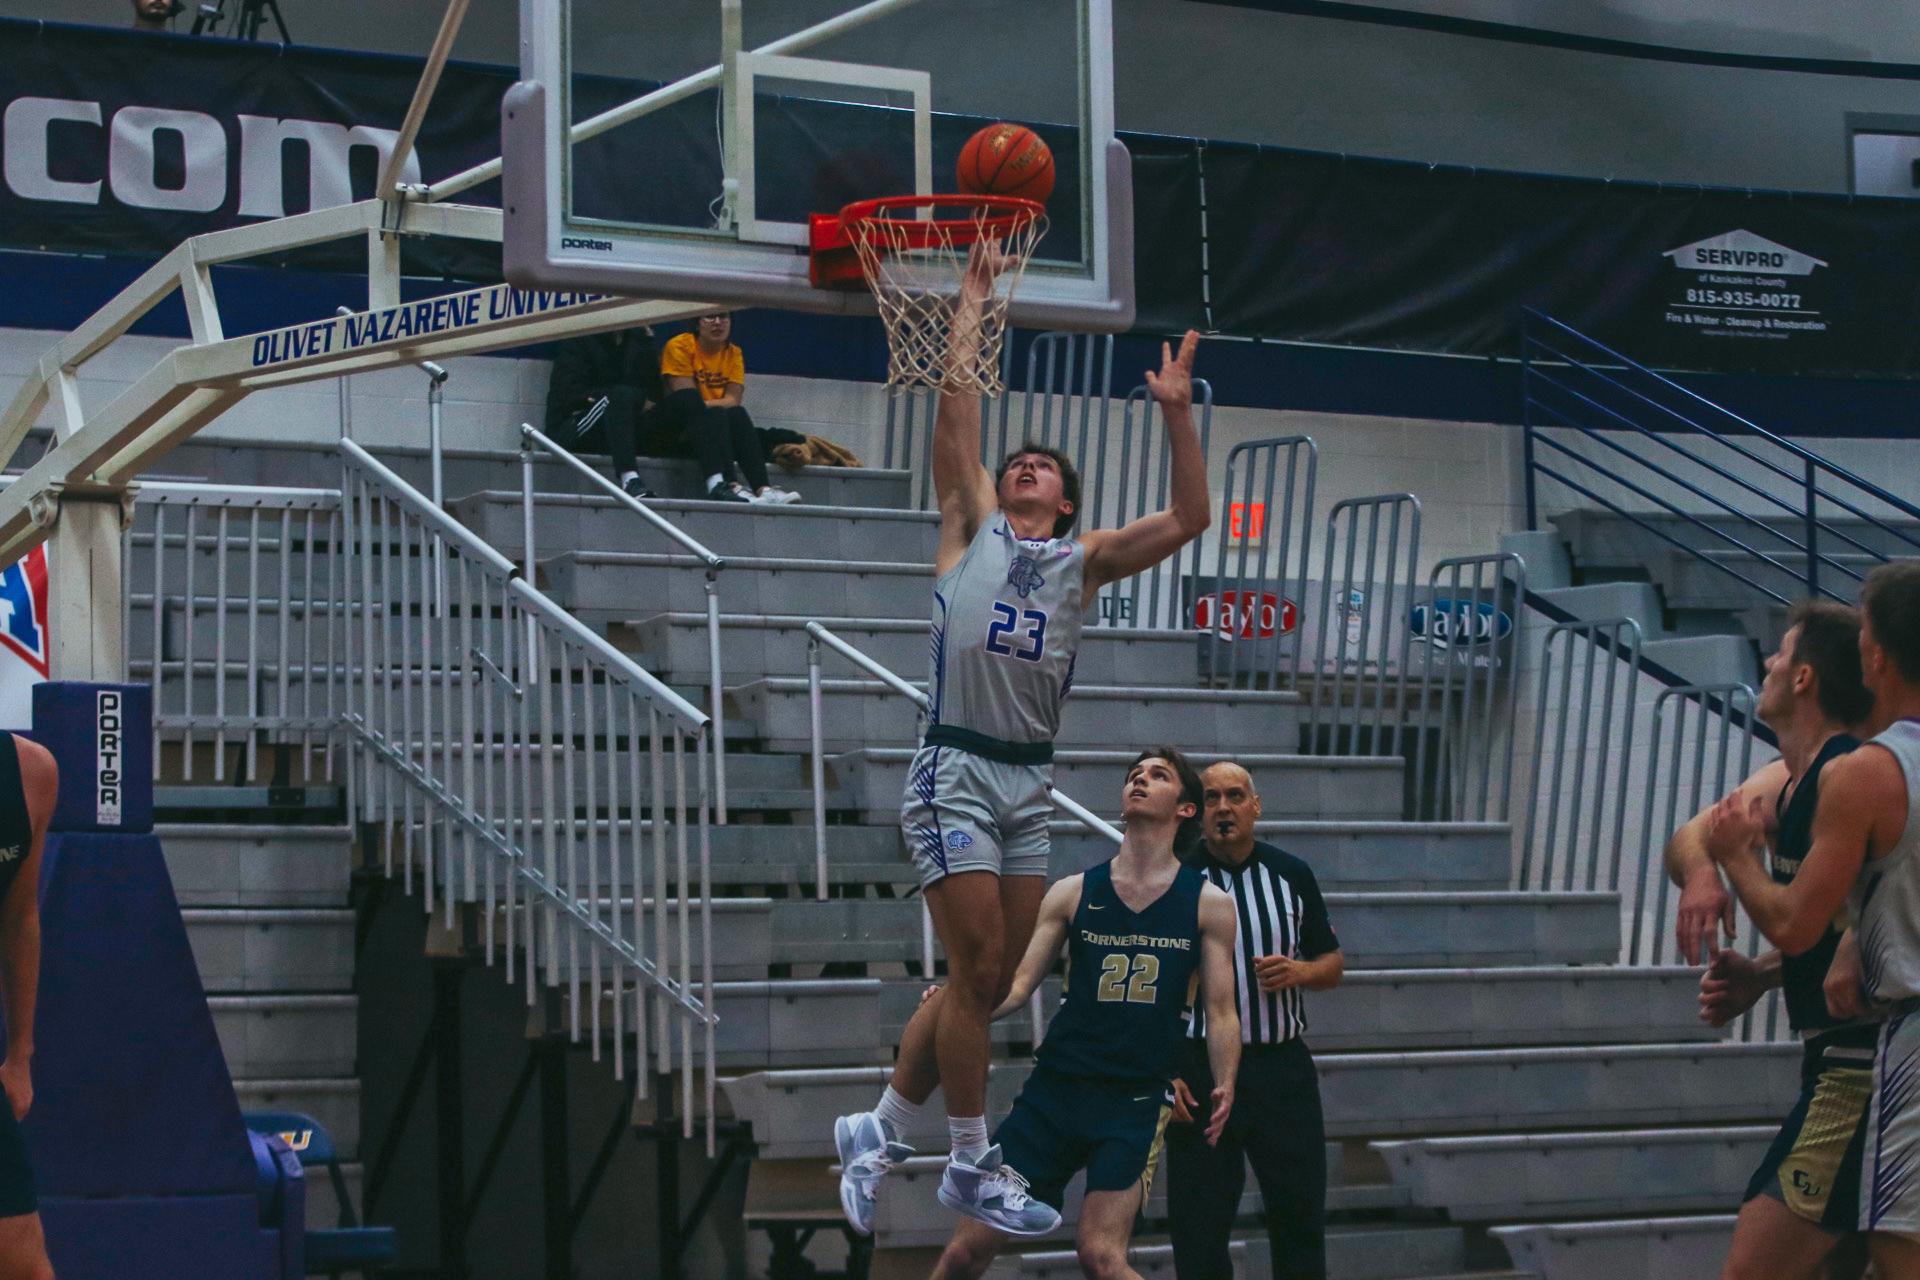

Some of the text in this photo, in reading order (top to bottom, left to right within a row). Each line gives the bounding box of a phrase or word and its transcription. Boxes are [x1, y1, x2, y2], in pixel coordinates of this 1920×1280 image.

[1696, 248, 1784, 267] SERVPRO
[1698, 273, 1787, 288] of Kankakee County
[1686, 288, 1802, 308] 815-935-0077
[252, 322, 337, 366] OLIVET
[343, 293, 481, 349] NAZARENE
[1665, 312, 1683, 323] Fire
[1684, 313, 1692, 323] &
[1692, 314, 1720, 325] Water
[1726, 317, 1763, 329] Cleanup
[1763, 319, 1772, 329] &
[1773, 319, 1827, 331] Restoration
[985, 600, 1048, 662] 23
[1081, 930, 1192, 951] CORNERSTONE
[1097, 953, 1160, 1004] 22
